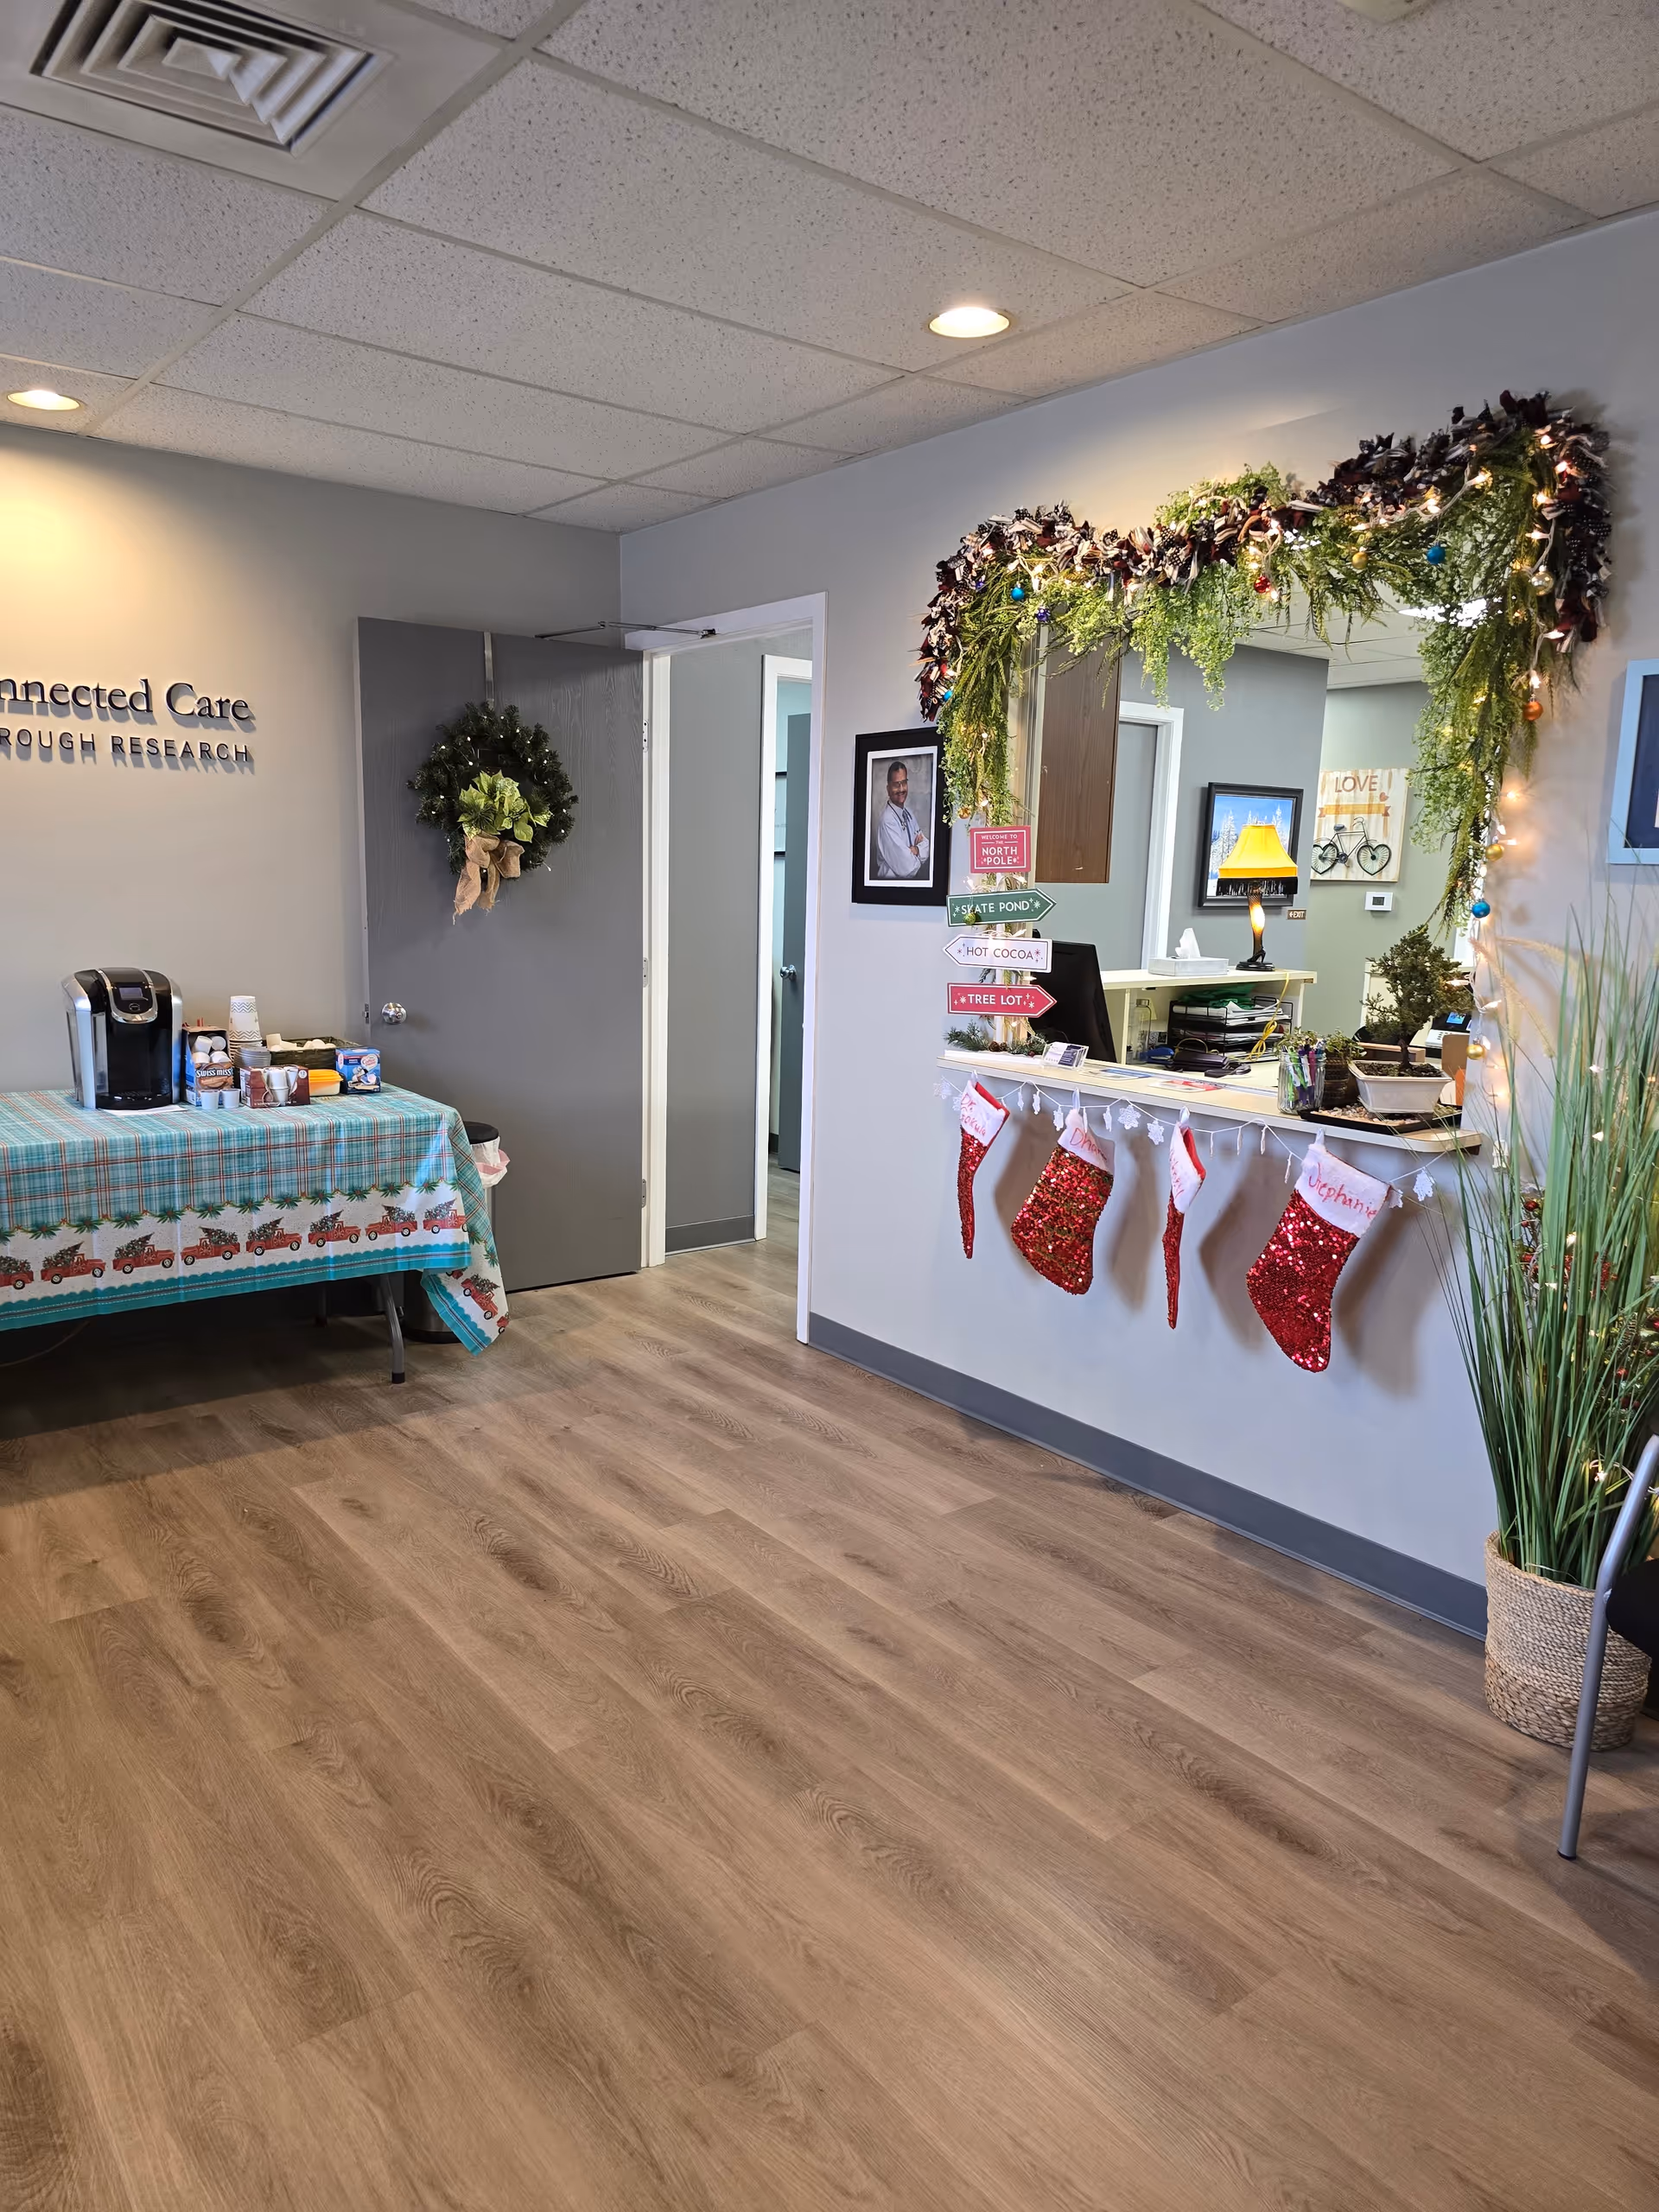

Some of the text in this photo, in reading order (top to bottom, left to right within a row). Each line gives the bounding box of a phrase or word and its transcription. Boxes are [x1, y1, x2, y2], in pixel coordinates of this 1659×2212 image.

[166, 682, 250, 721] Care
[0, 728, 249, 761] ROUGH RESEARCH
[1334, 774, 1378, 792] LOVE
[982, 846, 1018, 855] NORTH
[987, 855, 1013, 865] POLE
[961, 900, 1030, 915] SKATE POND
[966, 946, 1034, 960] HOT COCOA
[967, 994, 1023, 1006] TREE LOT
